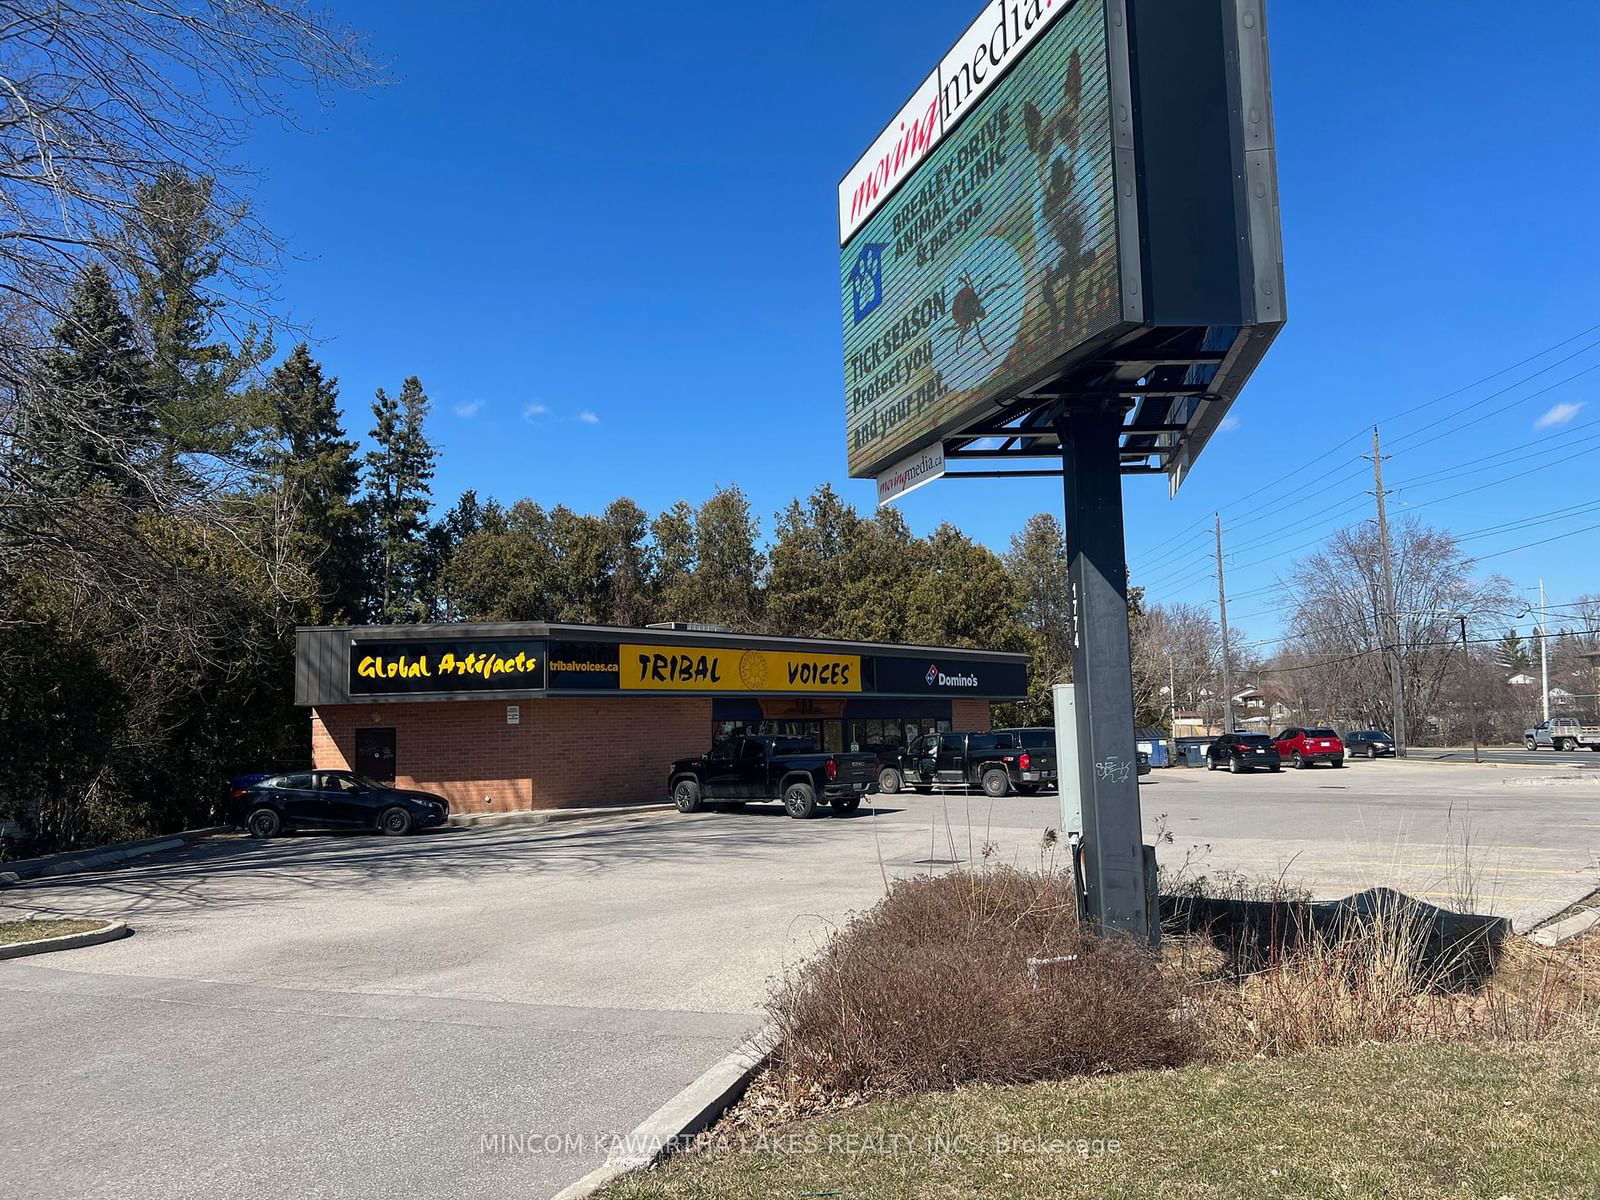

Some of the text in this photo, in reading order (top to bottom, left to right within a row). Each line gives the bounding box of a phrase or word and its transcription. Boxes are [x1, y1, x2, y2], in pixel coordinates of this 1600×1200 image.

[892, 103, 1010, 236] BREALEY DRIVE
[894, 136, 1007, 262] ANIMAL CLINIC
[916, 200, 983, 268] & pet spa
[851, 287, 946, 383] TICK SEASON
[852, 340, 933, 413] Protect you
[854, 369, 948, 449] and your pet.
[880, 456, 942, 494] movingmedia.ca
[358, 652, 536, 679] Global Artifacts
[549, 661, 618, 671] tribalvoices.ca
[638, 654, 849, 685] TRIBAL VOICES
[938, 673, 978, 687] Domino's
